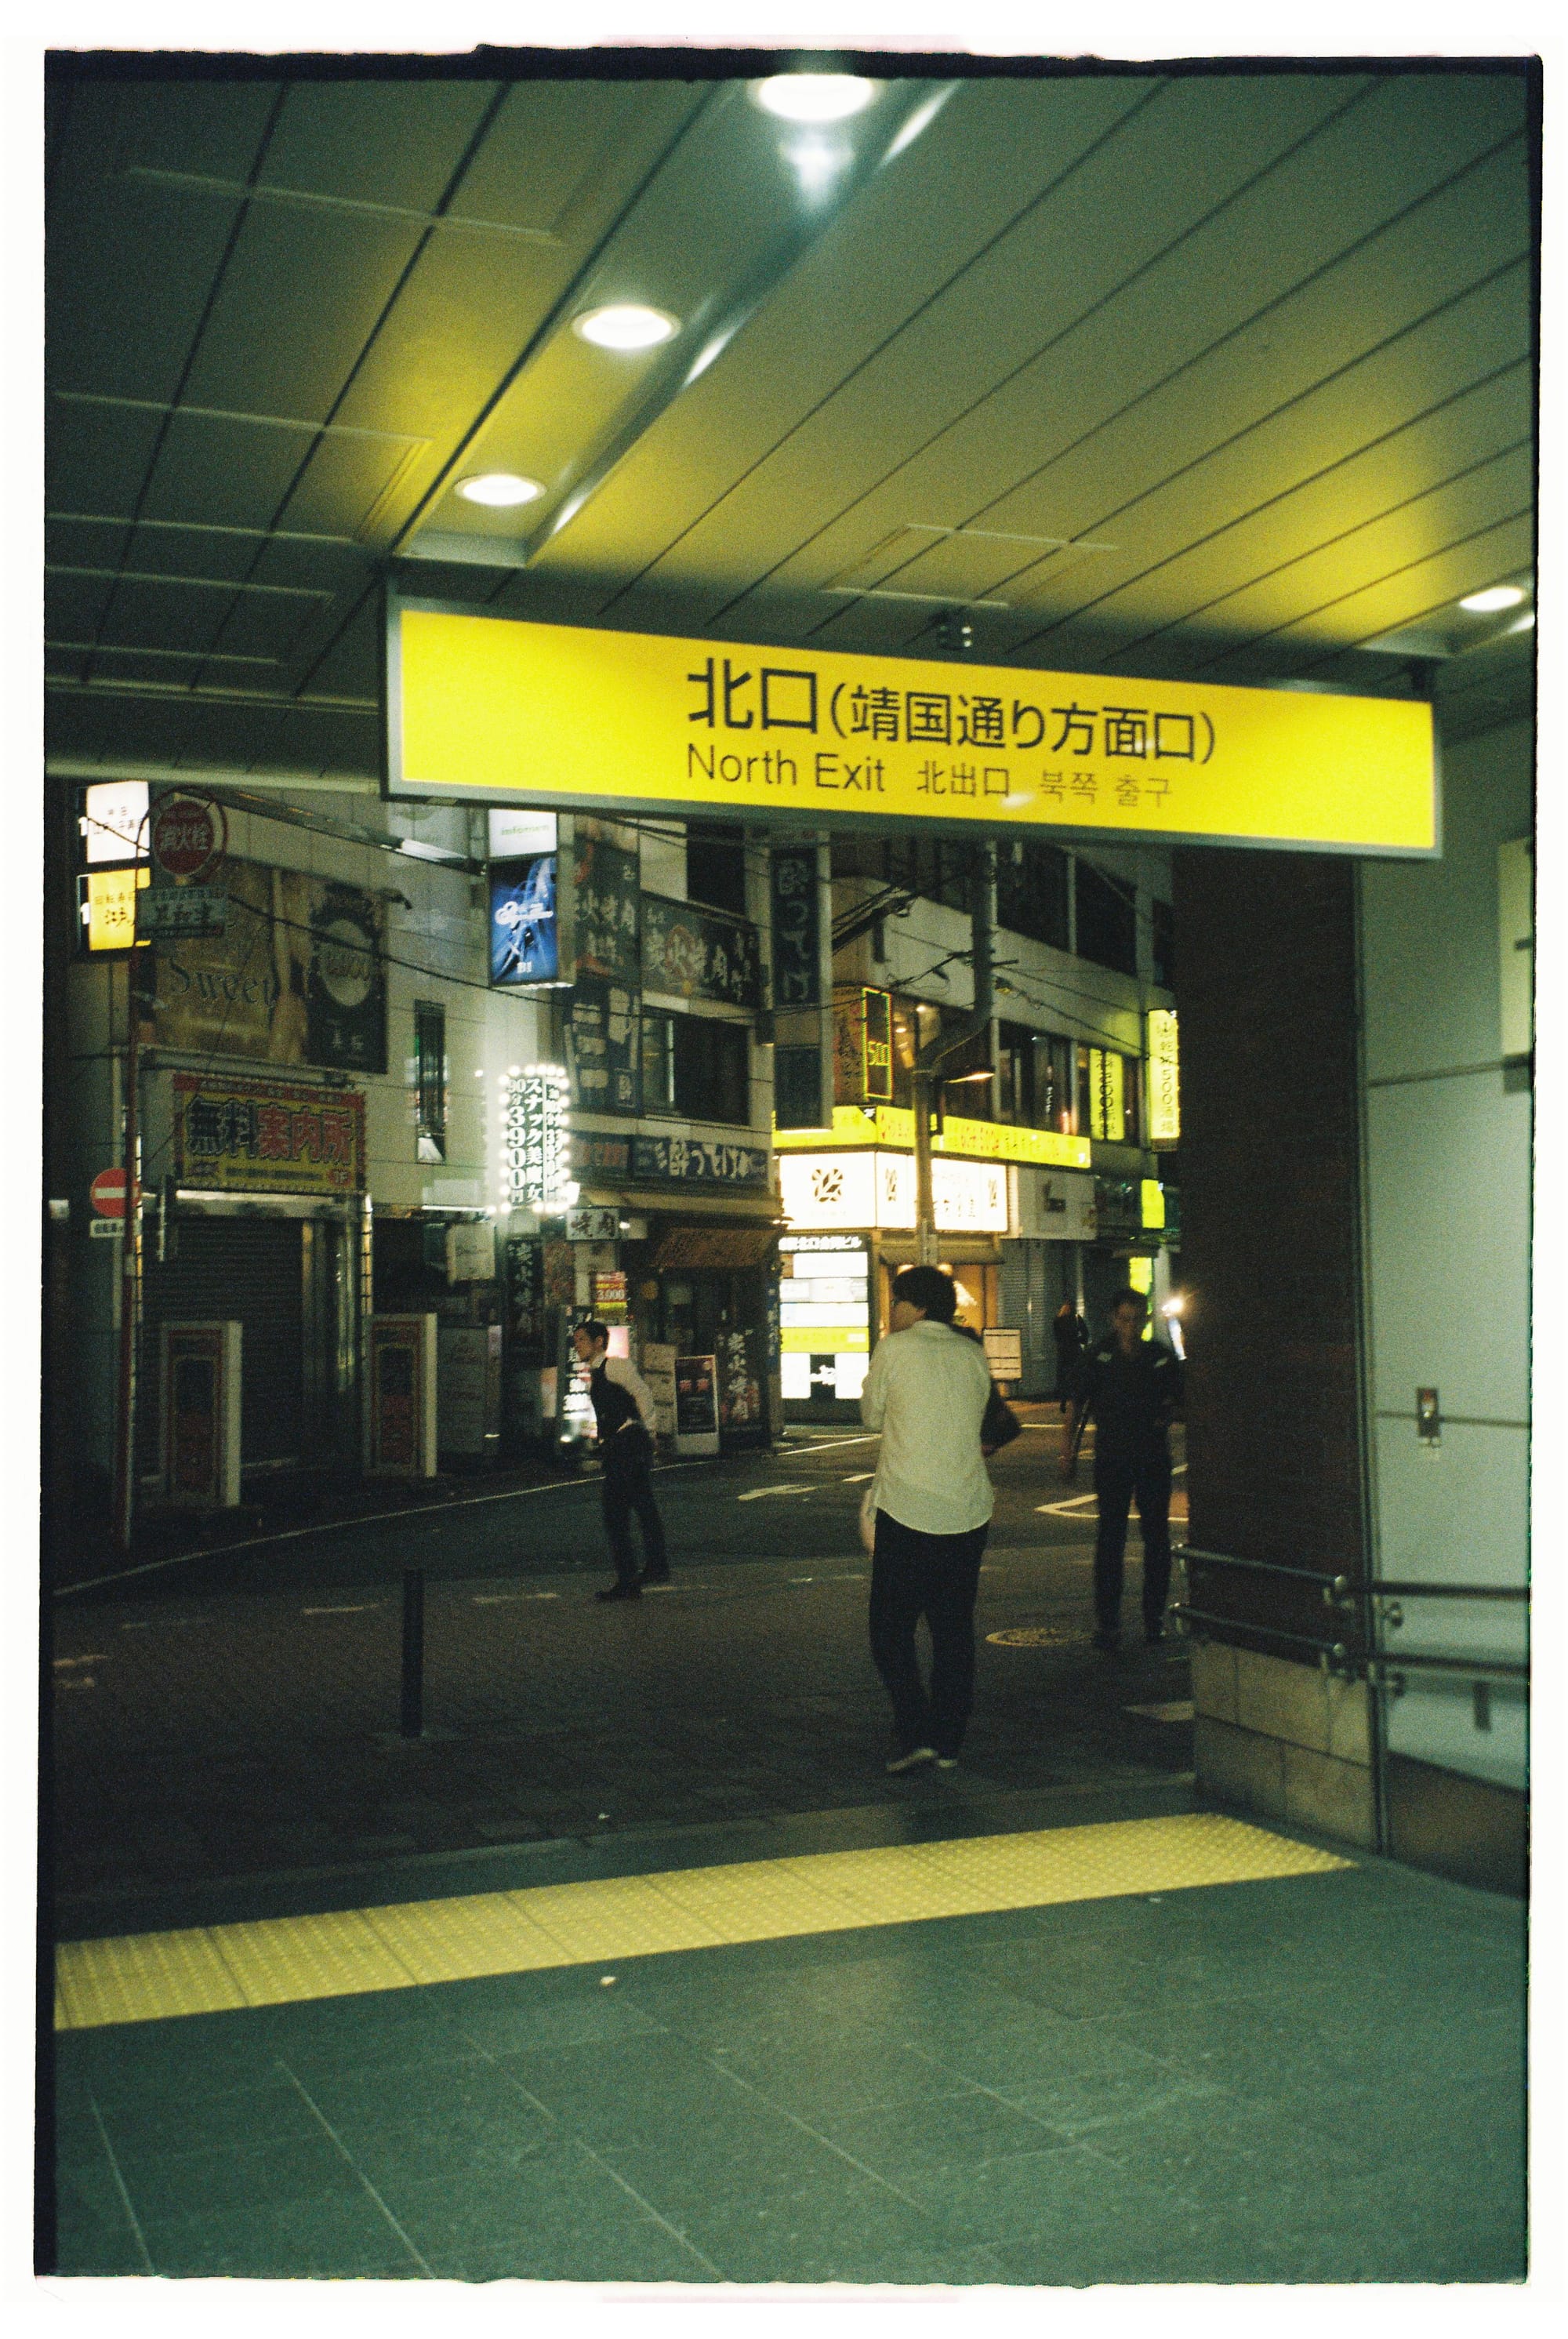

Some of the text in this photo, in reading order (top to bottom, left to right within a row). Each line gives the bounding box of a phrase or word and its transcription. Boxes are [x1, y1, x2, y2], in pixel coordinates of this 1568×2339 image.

[687, 657, 1216, 765] 北口(靖国通り方面口)
[687, 744, 885, 793] North Exit
[916, 760, 1011, 797] 北出口
[1040, 771, 1173, 808] 북쪽 출구
[187, 1095, 354, 1166] 無料案内所
